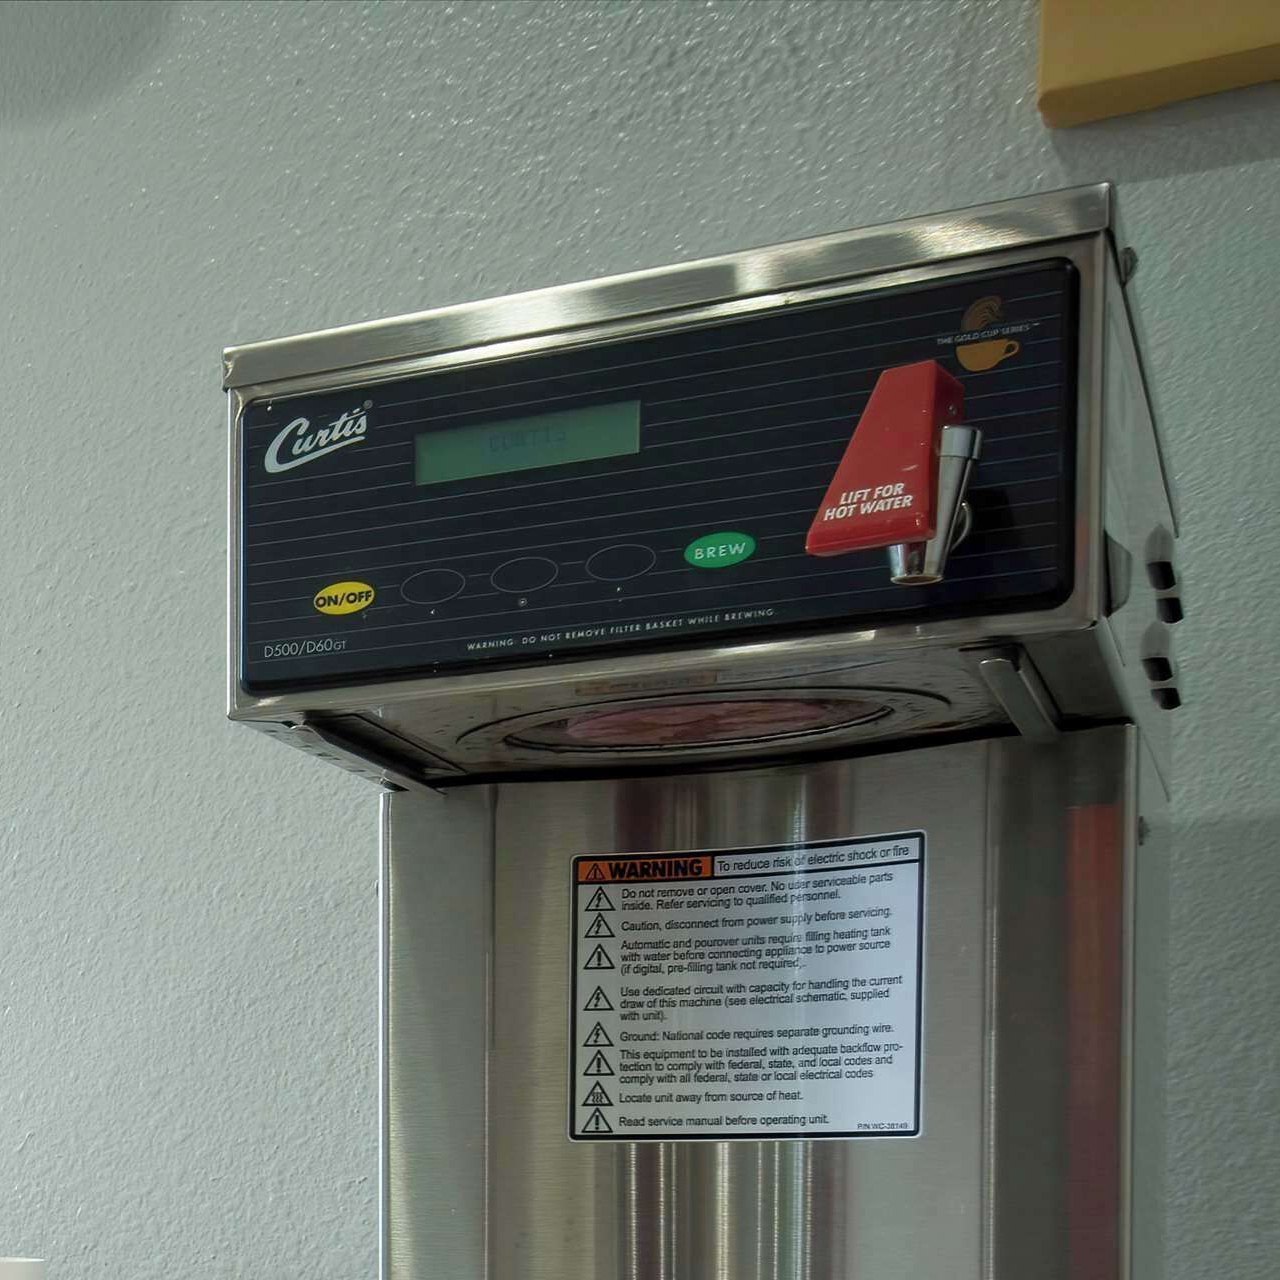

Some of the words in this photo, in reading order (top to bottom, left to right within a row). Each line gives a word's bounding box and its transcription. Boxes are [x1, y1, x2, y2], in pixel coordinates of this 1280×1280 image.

[265, 408, 367, 473] Curtis
[839, 486, 871, 505] LIFT
[874, 482, 905, 500] FOR
[824, 504, 856, 522] HOT
[860, 494, 913, 516] WATER
[694, 541, 746, 560] BREW
[315, 589, 372, 608] ON/OFF
[522, 636, 537, 645] DO
[541, 633, 561, 642] NOT
[565, 628, 605, 640] REMOVE
[609, 623, 641, 634] FILTER
[645, 619, 683, 631] BASKET
[688, 614, 719, 626] WHILE
[264, 638, 346, 659] D500/D60GT
[609, 859, 703, 879] WARNING
[733, 858, 771, 869] reduce
[772, 855, 792, 867] risk
[807, 851, 845, 864] electric
[847, 848, 877, 861] shock
[892, 846, 911, 857] fire
[638, 887, 655, 898] not
[657, 888, 695, 897] remove
[710, 885, 735, 895] open
[738, 883, 768, 893] cover.
[812, 873, 867, 888] serviceable
[868, 871, 893, 884] parts
[621, 900, 652, 910] inside.
[656, 899, 684, 909] Refer
[686, 897, 731, 908] servicing
[746, 893, 788, 907] qualified
[621, 920, 662, 931] Caution,
[665, 917, 719, 929] disconnect
[721, 917, 745, 927] from
[746, 916, 778, 927] power
[780, 912, 812, 924] supply
[814, 910, 846, 921] before
[621, 938, 671, 949] Automatic
[672, 937, 692, 948] and
[694, 937, 739, 948] pourover
[741, 934, 766, 945] units
[805, 931, 831, 942] filling
[833, 928, 869, 940] heating
[870, 925, 891, 937] tank
[620, 952, 641, 962] with
[643, 951, 671, 962] water
[672, 950, 706, 961] before
[707, 948, 762, 960] connecting
[826, 942, 857, 954] power
[858, 939, 891, 950] source
[667, 961, 713, 973] pre-filling
[715, 960, 737, 971] tank
[739, 959, 757, 970] not
[620, 986, 640, 997] Use
[642, 985, 691, 996] dedicated
[693, 984, 724, 995] circuit
[725, 983, 747, 994] with
[749, 981, 789, 993] capacity
[792, 980, 806, 991] for
[808, 978, 850, 990] handling
[851, 977, 868, 988] the
[868, 974, 903, 986] current
[620, 999, 645, 1009] draw
[659, 998, 677, 1008] this
[679, 996, 721, 1008] machine
[724, 996, 747, 1007] (see
[749, 993, 794, 1005] electrical
[850, 989, 889, 1002] supplied
[620, 1011, 640, 1022] with
[662, 1030, 704, 1041] National
[706, 1029, 731, 1040] code
[733, 1028, 774, 1040] requires
[776, 1026, 820, 1038] separate
[821, 1025, 869, 1037] grounding
[621, 1049, 641, 1060] This
[643, 1048, 695, 1060] equipment
[725, 1046, 767, 1058] installed
[769, 1045, 789, 1056] with
[792, 1044, 838, 1056] adequate
[840, 1042, 882, 1054] backflow
[619, 1061, 652, 1072] tection
[666, 1060, 702, 1072] comply
[705, 1060, 725, 1070] with
[798, 1057, 817, 1068] and
[819, 1056, 843, 1067] local
[843, 1056, 873, 1066] codes
[875, 1055, 893, 1065] and
[619, 1073, 654, 1085] comply
[656, 1073, 677, 1083] with
[679, 1073, 691, 1083] all
[734, 1071, 759, 1082] state
[773, 1070, 798, 1081] local
[800, 1069, 843, 1080] electrical
[845, 1068, 873, 1079] codes
[619, 1092, 652, 1103] Locate
[654, 1092, 673, 1102] unit
[675, 1094, 701, 1103] away
[704, 1091, 727, 1102] from
[730, 1093, 764, 1101] source
[618, 1116, 645, 1126] Read
[648, 1116, 683, 1126] service
[686, 1115, 723, 1126] manual
[725, 1115, 758, 1125] before
[759, 1114, 807, 1126] operating
